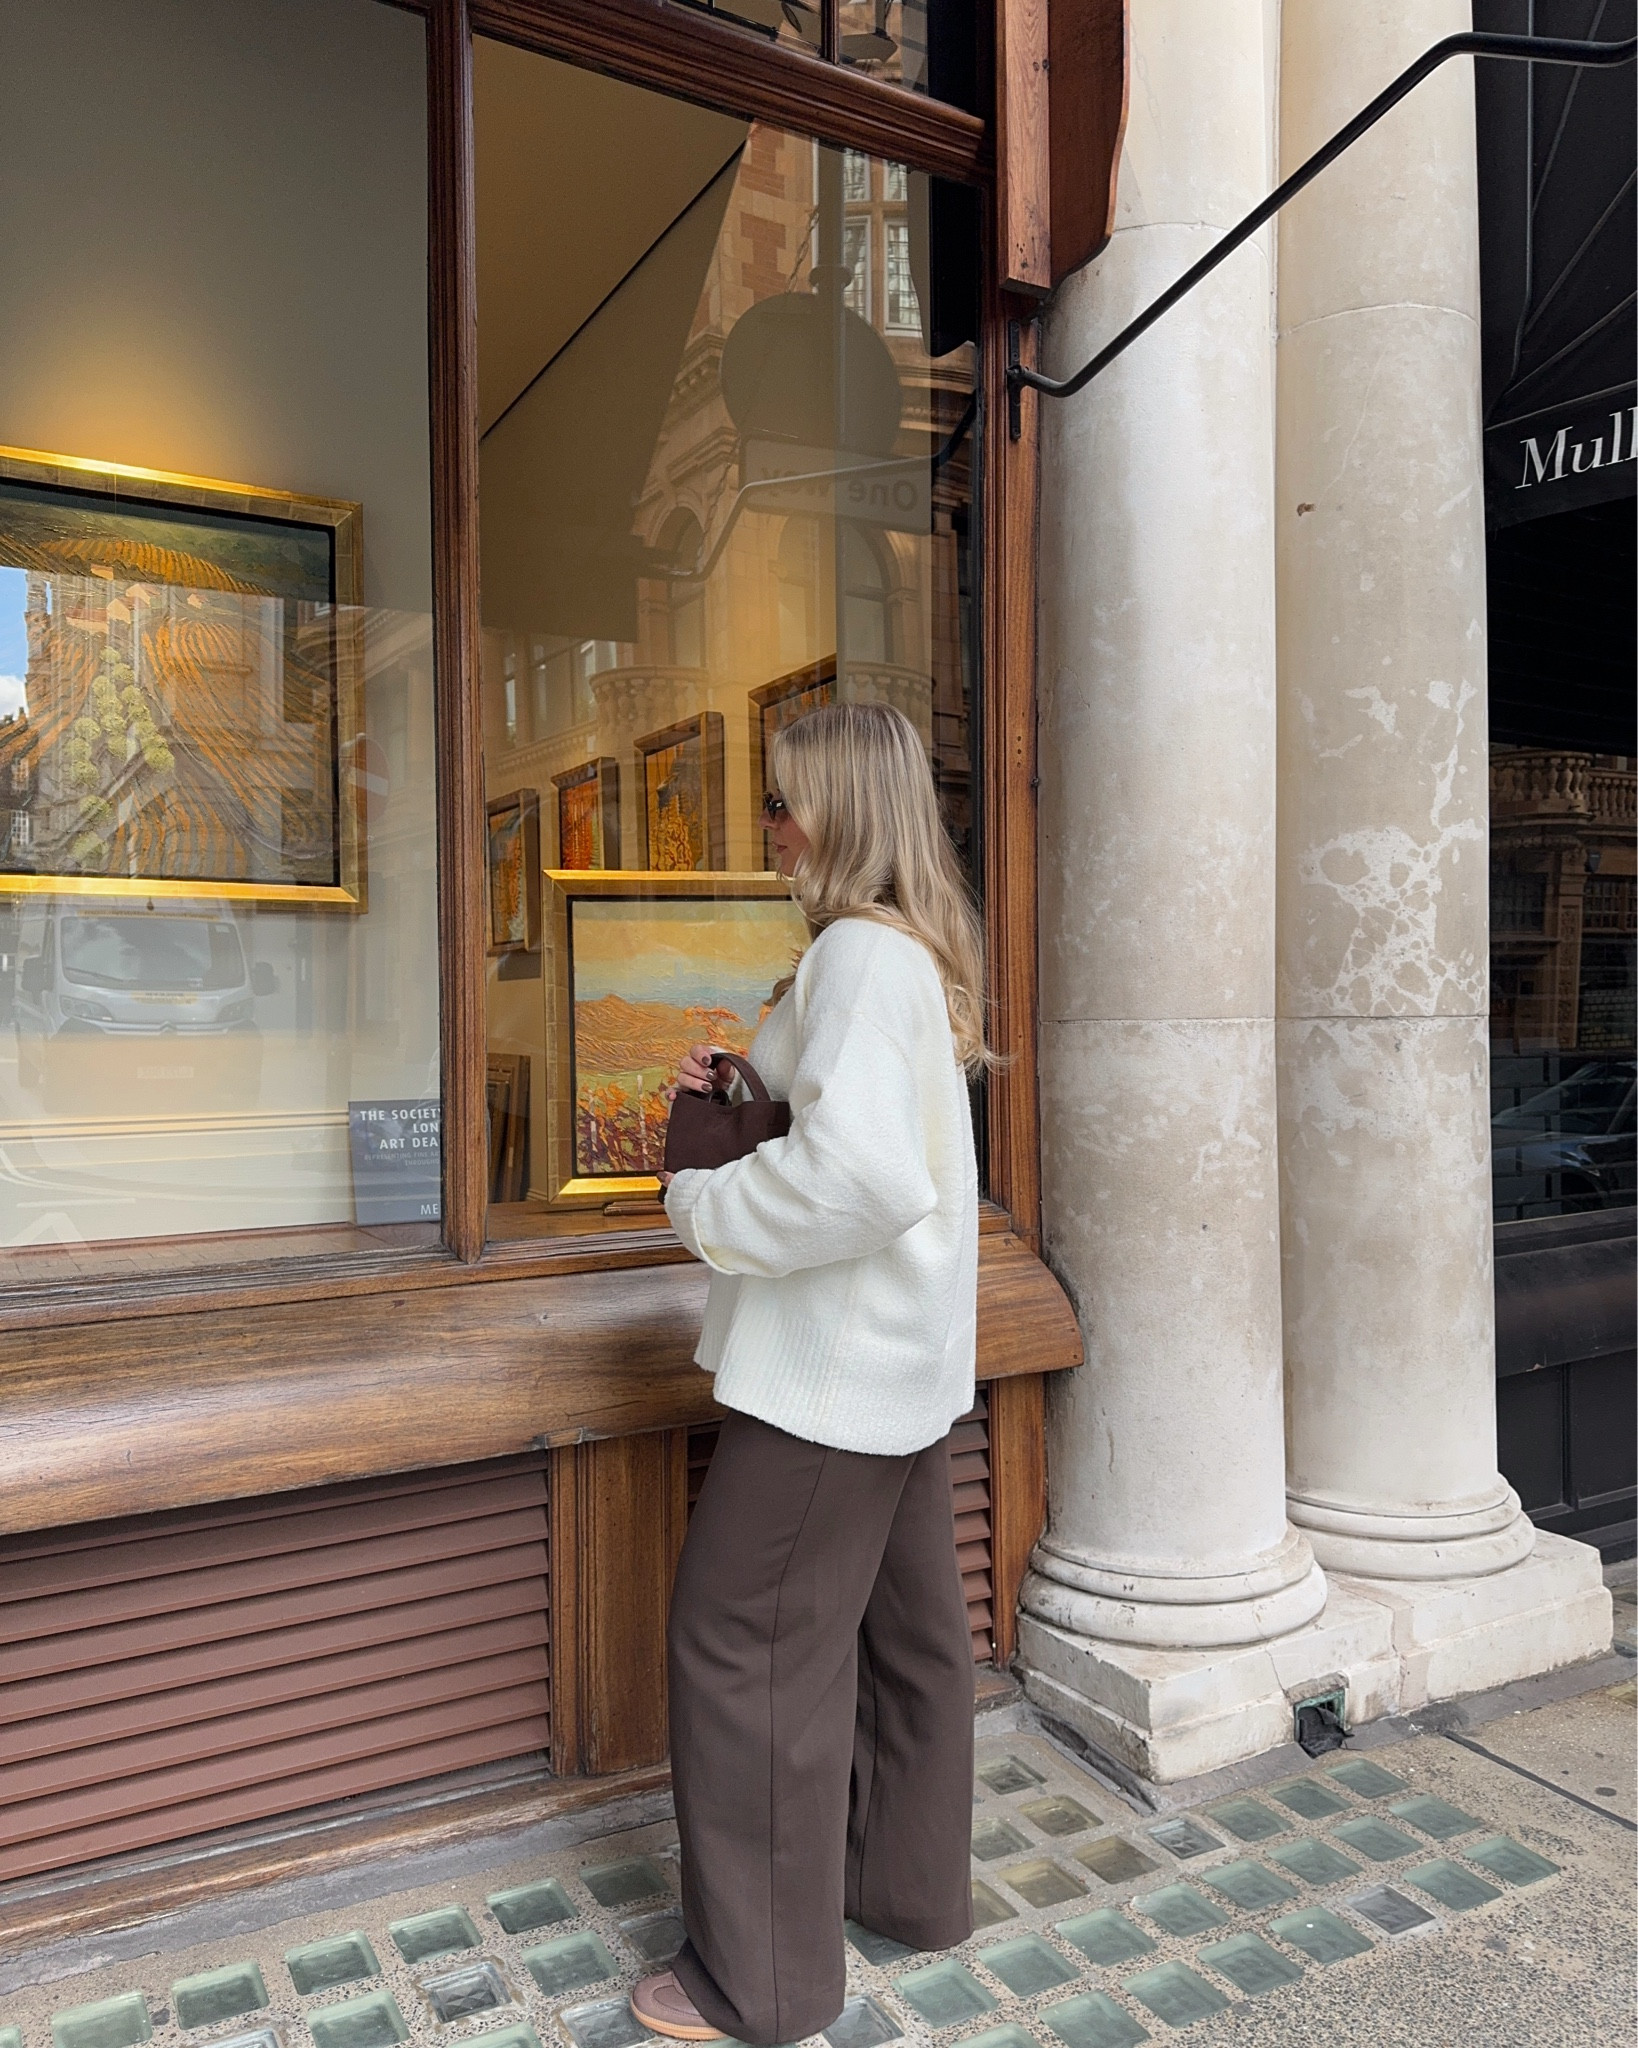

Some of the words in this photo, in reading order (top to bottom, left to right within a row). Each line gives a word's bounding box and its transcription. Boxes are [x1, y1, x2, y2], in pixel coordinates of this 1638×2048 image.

[1514, 406, 1637, 490] Mull
[360, 1110, 385, 1121] THE
[391, 1108, 441, 1120] SOCIET
[413, 1122, 439, 1134] LON
[379, 1138, 406, 1150] ART
[412, 1137, 439, 1148] DEA
[420, 1203, 439, 1215] ME
